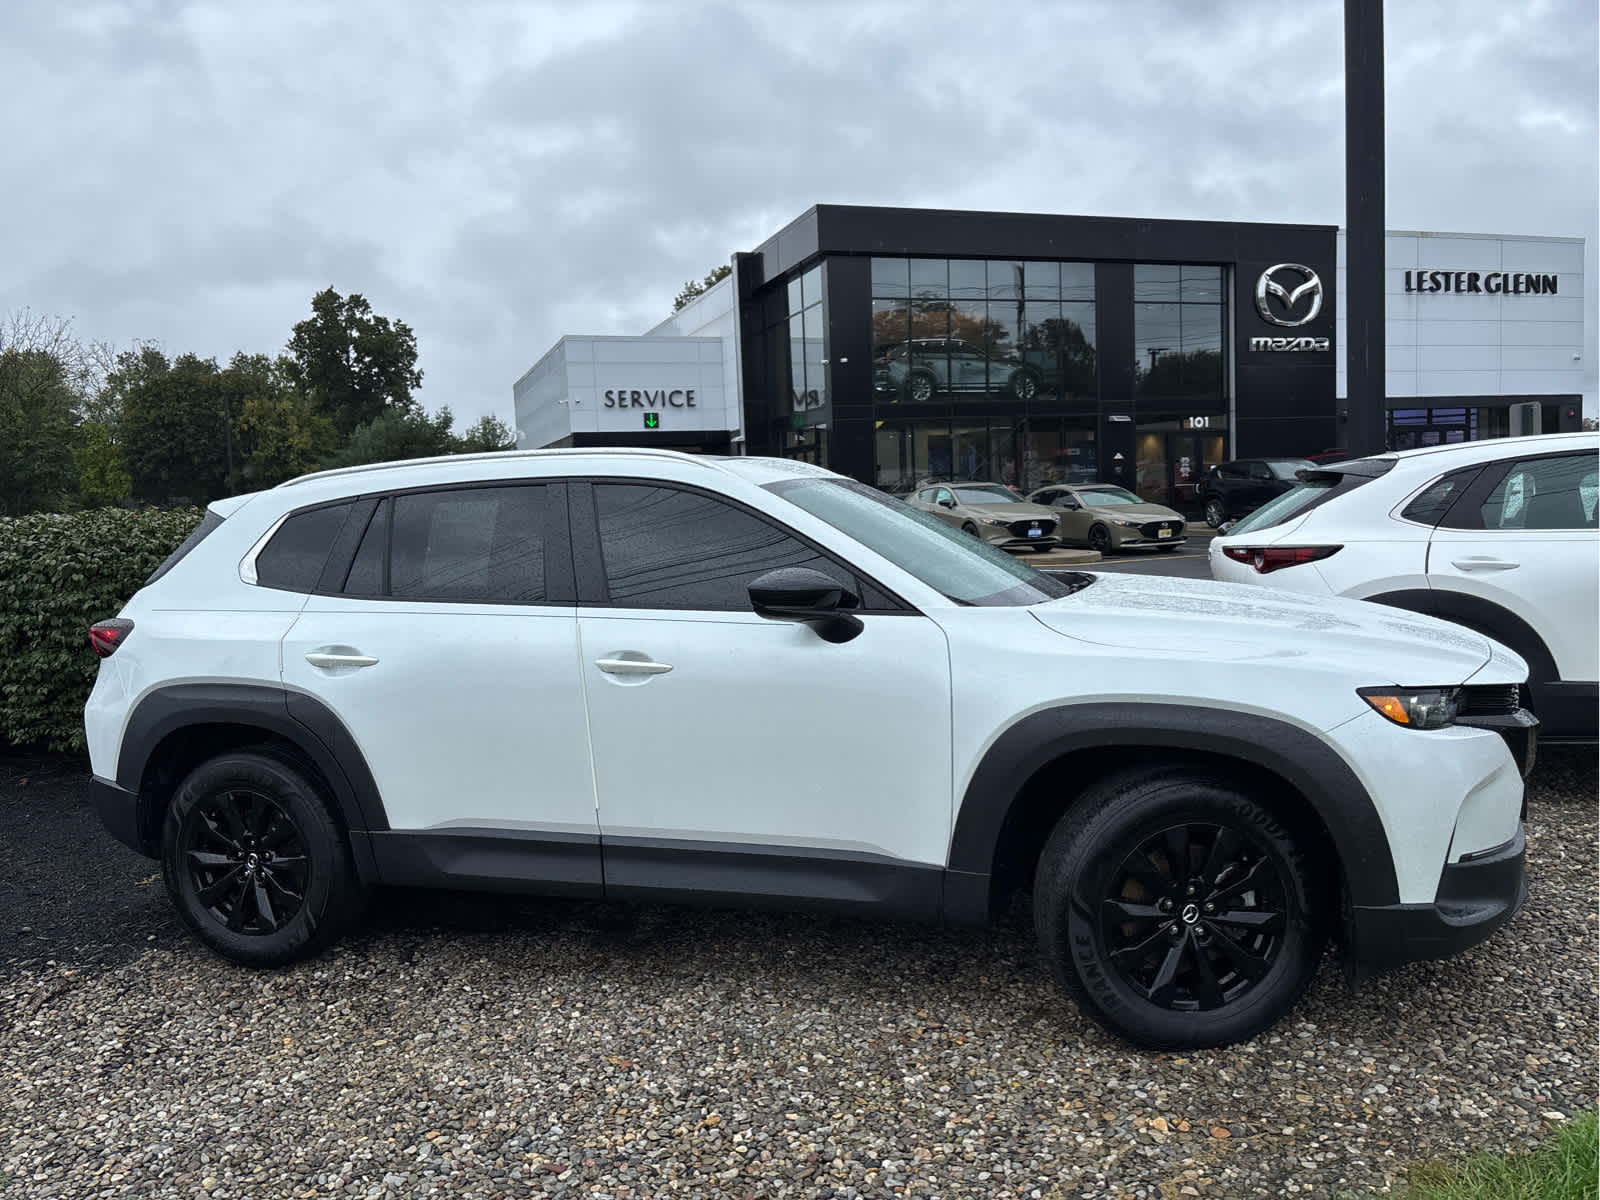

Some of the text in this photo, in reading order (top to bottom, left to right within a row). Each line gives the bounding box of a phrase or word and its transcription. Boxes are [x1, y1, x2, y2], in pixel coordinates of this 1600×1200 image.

[1404, 270, 1559, 295] LESTER GLENN
[603, 389, 697, 408] SERVICE
[1188, 416, 1210, 428] 101
